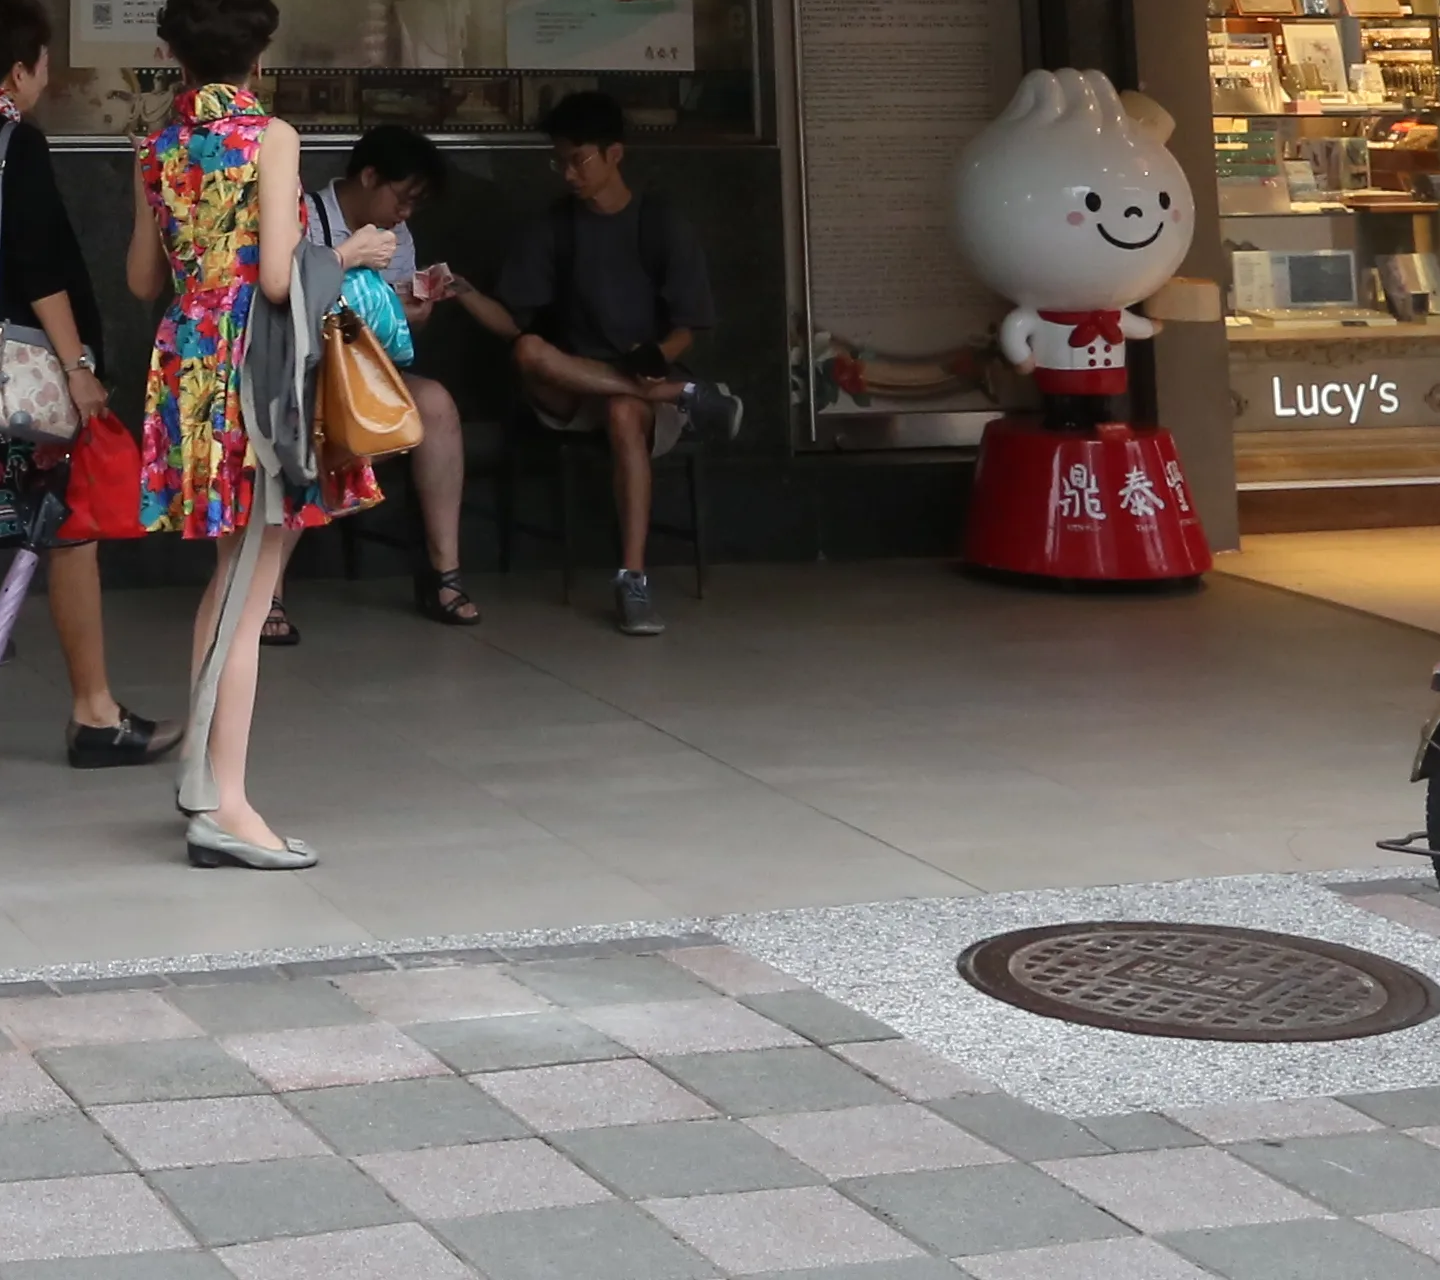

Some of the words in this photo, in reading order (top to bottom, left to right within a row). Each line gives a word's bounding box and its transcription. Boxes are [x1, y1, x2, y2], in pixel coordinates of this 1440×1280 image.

[1272, 374, 1400, 424] Lucy's
[1059, 461, 1189, 520] 鼎泰豐
